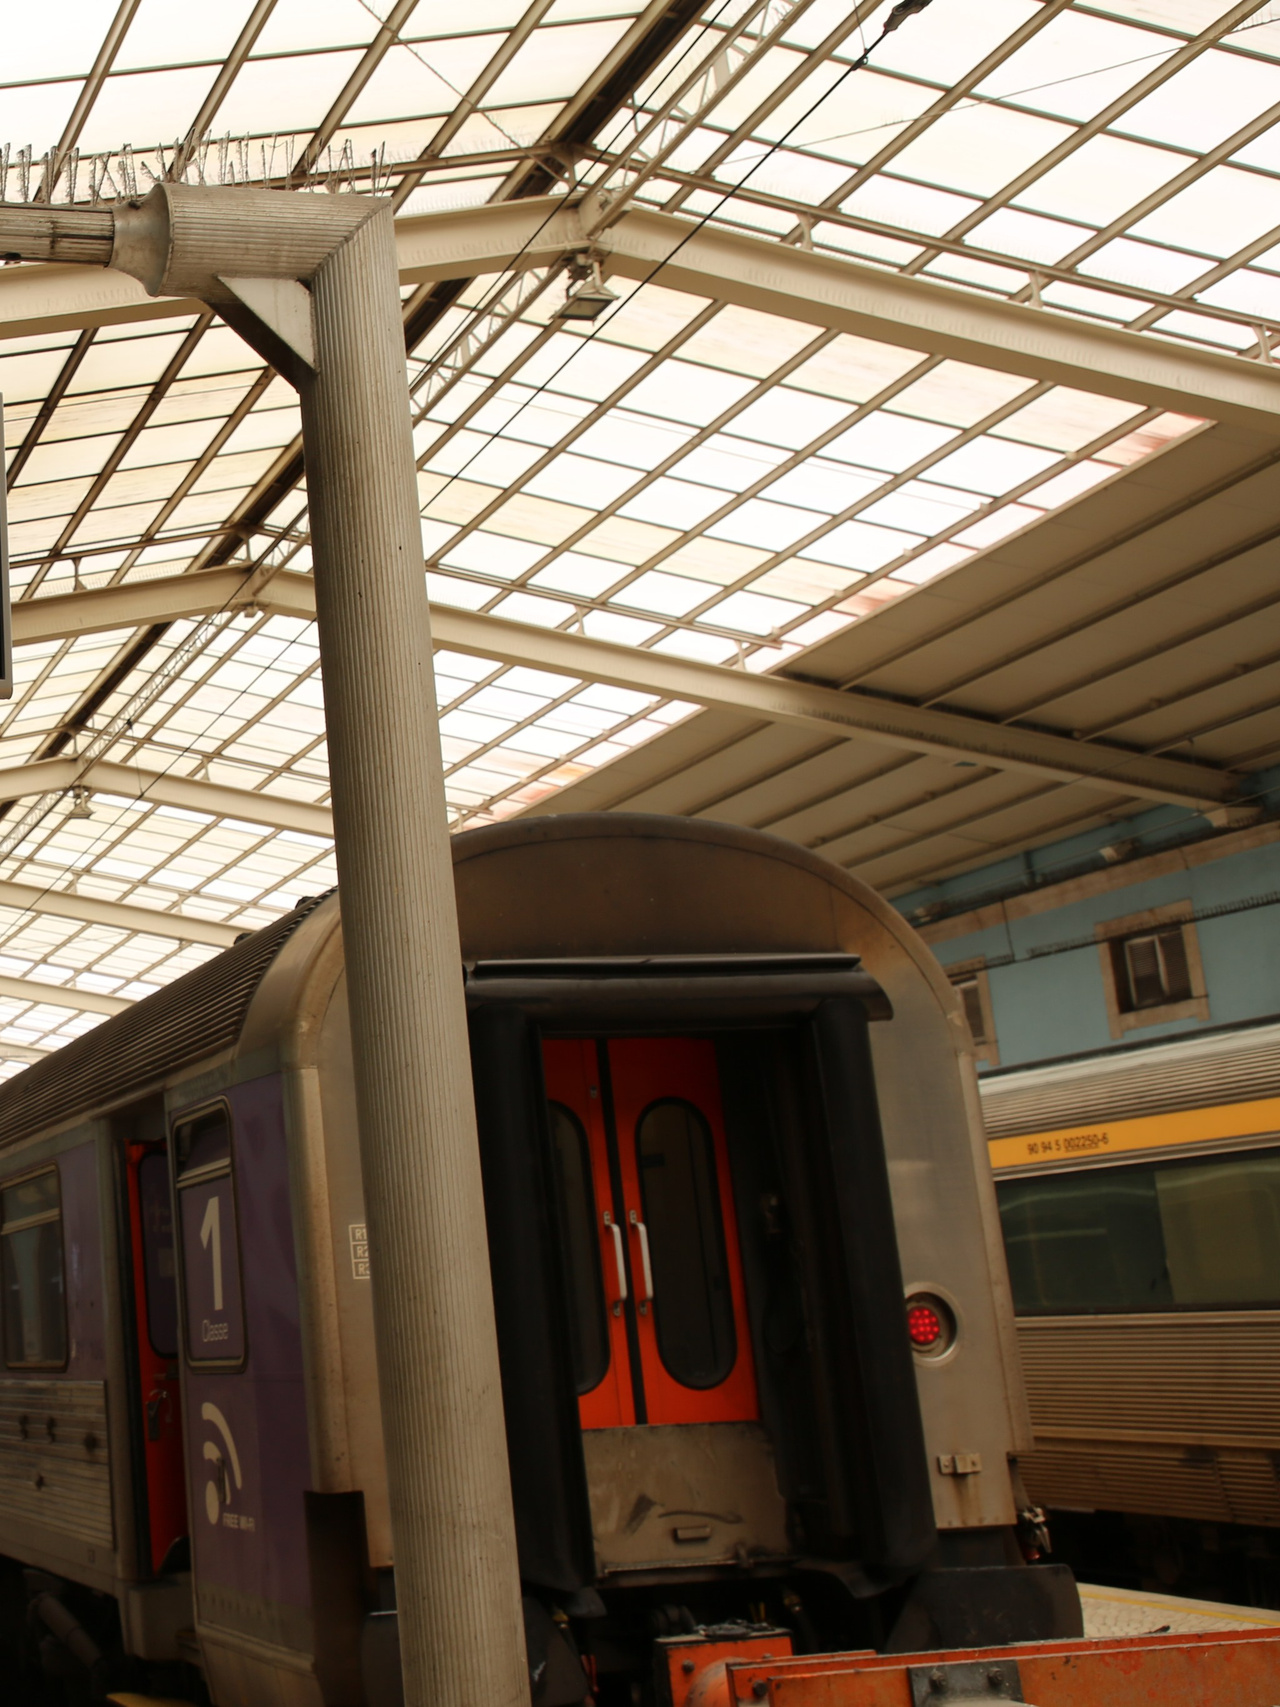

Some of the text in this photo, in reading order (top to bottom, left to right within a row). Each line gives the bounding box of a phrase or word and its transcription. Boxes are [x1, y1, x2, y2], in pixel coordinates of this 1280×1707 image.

[199, 1195, 224, 1311] 1
[202, 1318, 228, 1342] Classe
[222, 1512, 239, 1529] FREE
